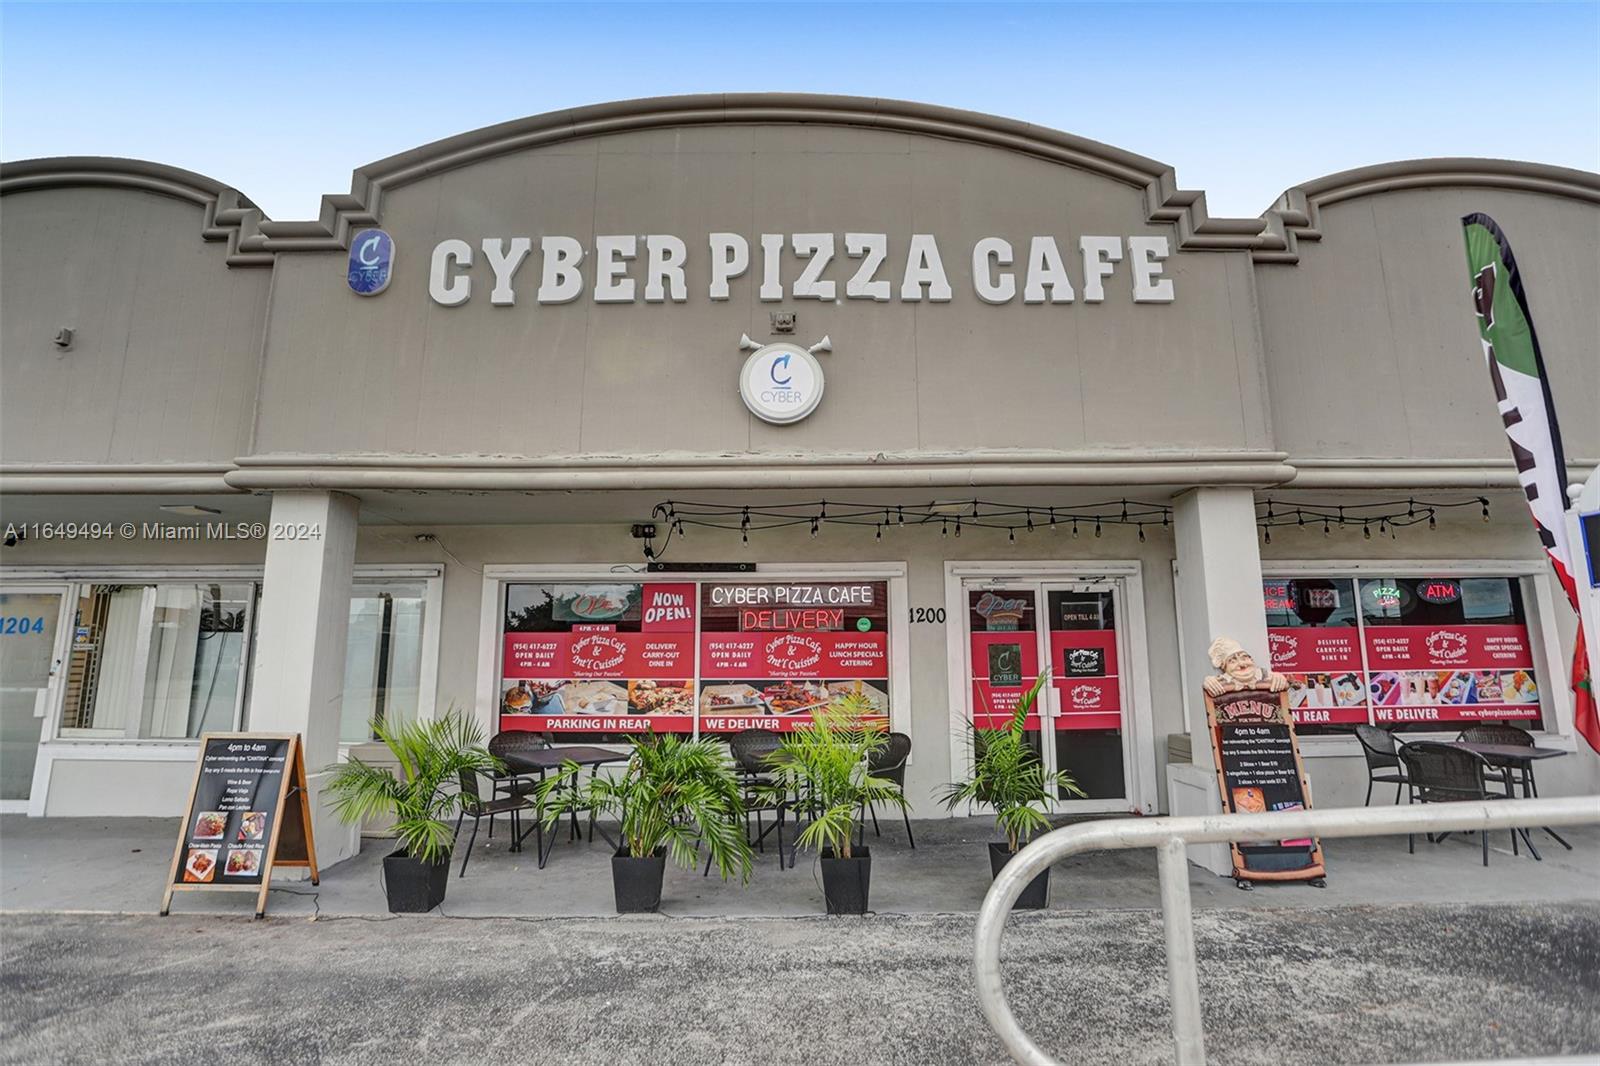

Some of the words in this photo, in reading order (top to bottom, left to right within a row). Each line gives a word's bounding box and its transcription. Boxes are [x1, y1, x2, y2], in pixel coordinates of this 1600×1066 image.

[429, 234, 688, 307] CYBER
[709, 232, 952, 303] PIZZA
[972, 235, 1175, 305] CAFE
[350, 271, 388, 283] CYBER
[760, 391, 803, 403] CYBER
[96, 584, 122, 593] 1204
[1264, 587, 1285, 596] ICE
[1373, 587, 1401, 600] PIZZA
[1426, 584, 1455, 599] ATM
[652, 591, 683, 607] NOW
[712, 587, 768, 604] CYBER
[775, 586, 823, 604] PIZZA
[828, 586, 872, 603] CAFE
[976, 593, 1027, 617] Open
[1264, 599, 1296, 609] REAM
[644, 607, 692, 624] OPEN!
[744, 610, 842, 629] DELIVERY
[909, 607, 946, 624] 1200
[0, 616, 44, 635] 1204
[1285, 635, 1298, 649] Cafe
[1425, 631, 1440, 646] Cyber
[1439, 630, 1455, 640] Pizza
[1454, 632, 1468, 646] Cafe
[513, 643, 529, 651] (954)
[571, 637, 589, 655] Cyber
[591, 634, 610, 645] Pizza
[610, 638, 627, 656] Cafe
[709, 643, 725, 651] (954)
[765, 637, 785, 654] Cyber
[785, 634, 805, 645] Pizza
[805, 637, 822, 655] Cafe
[592, 646, 602, 656] &
[787, 646, 797, 656] &
[1444, 647, 1467, 659] Cuisine
[593, 654, 624, 670] Cuisine
[788, 654, 820, 670] Cuisine
[993, 673, 1019, 682] CYBER
[1224, 700, 1275, 719] MENU
[1376, 709, 1393, 720] WE
[1395, 708, 1439, 720] DELIVER
[1303, 710, 1330, 722] REAR
[546, 718, 600, 729] PARKING
[603, 718, 614, 729] IN
[706, 719, 726, 729] WE
[728, 718, 779, 729] DELIVER
[1234, 728, 1248, 737] 4pm
[1256, 727, 1271, 735] 4am
[227, 744, 242, 753] 4pm
[251, 744, 267, 752] 4am
